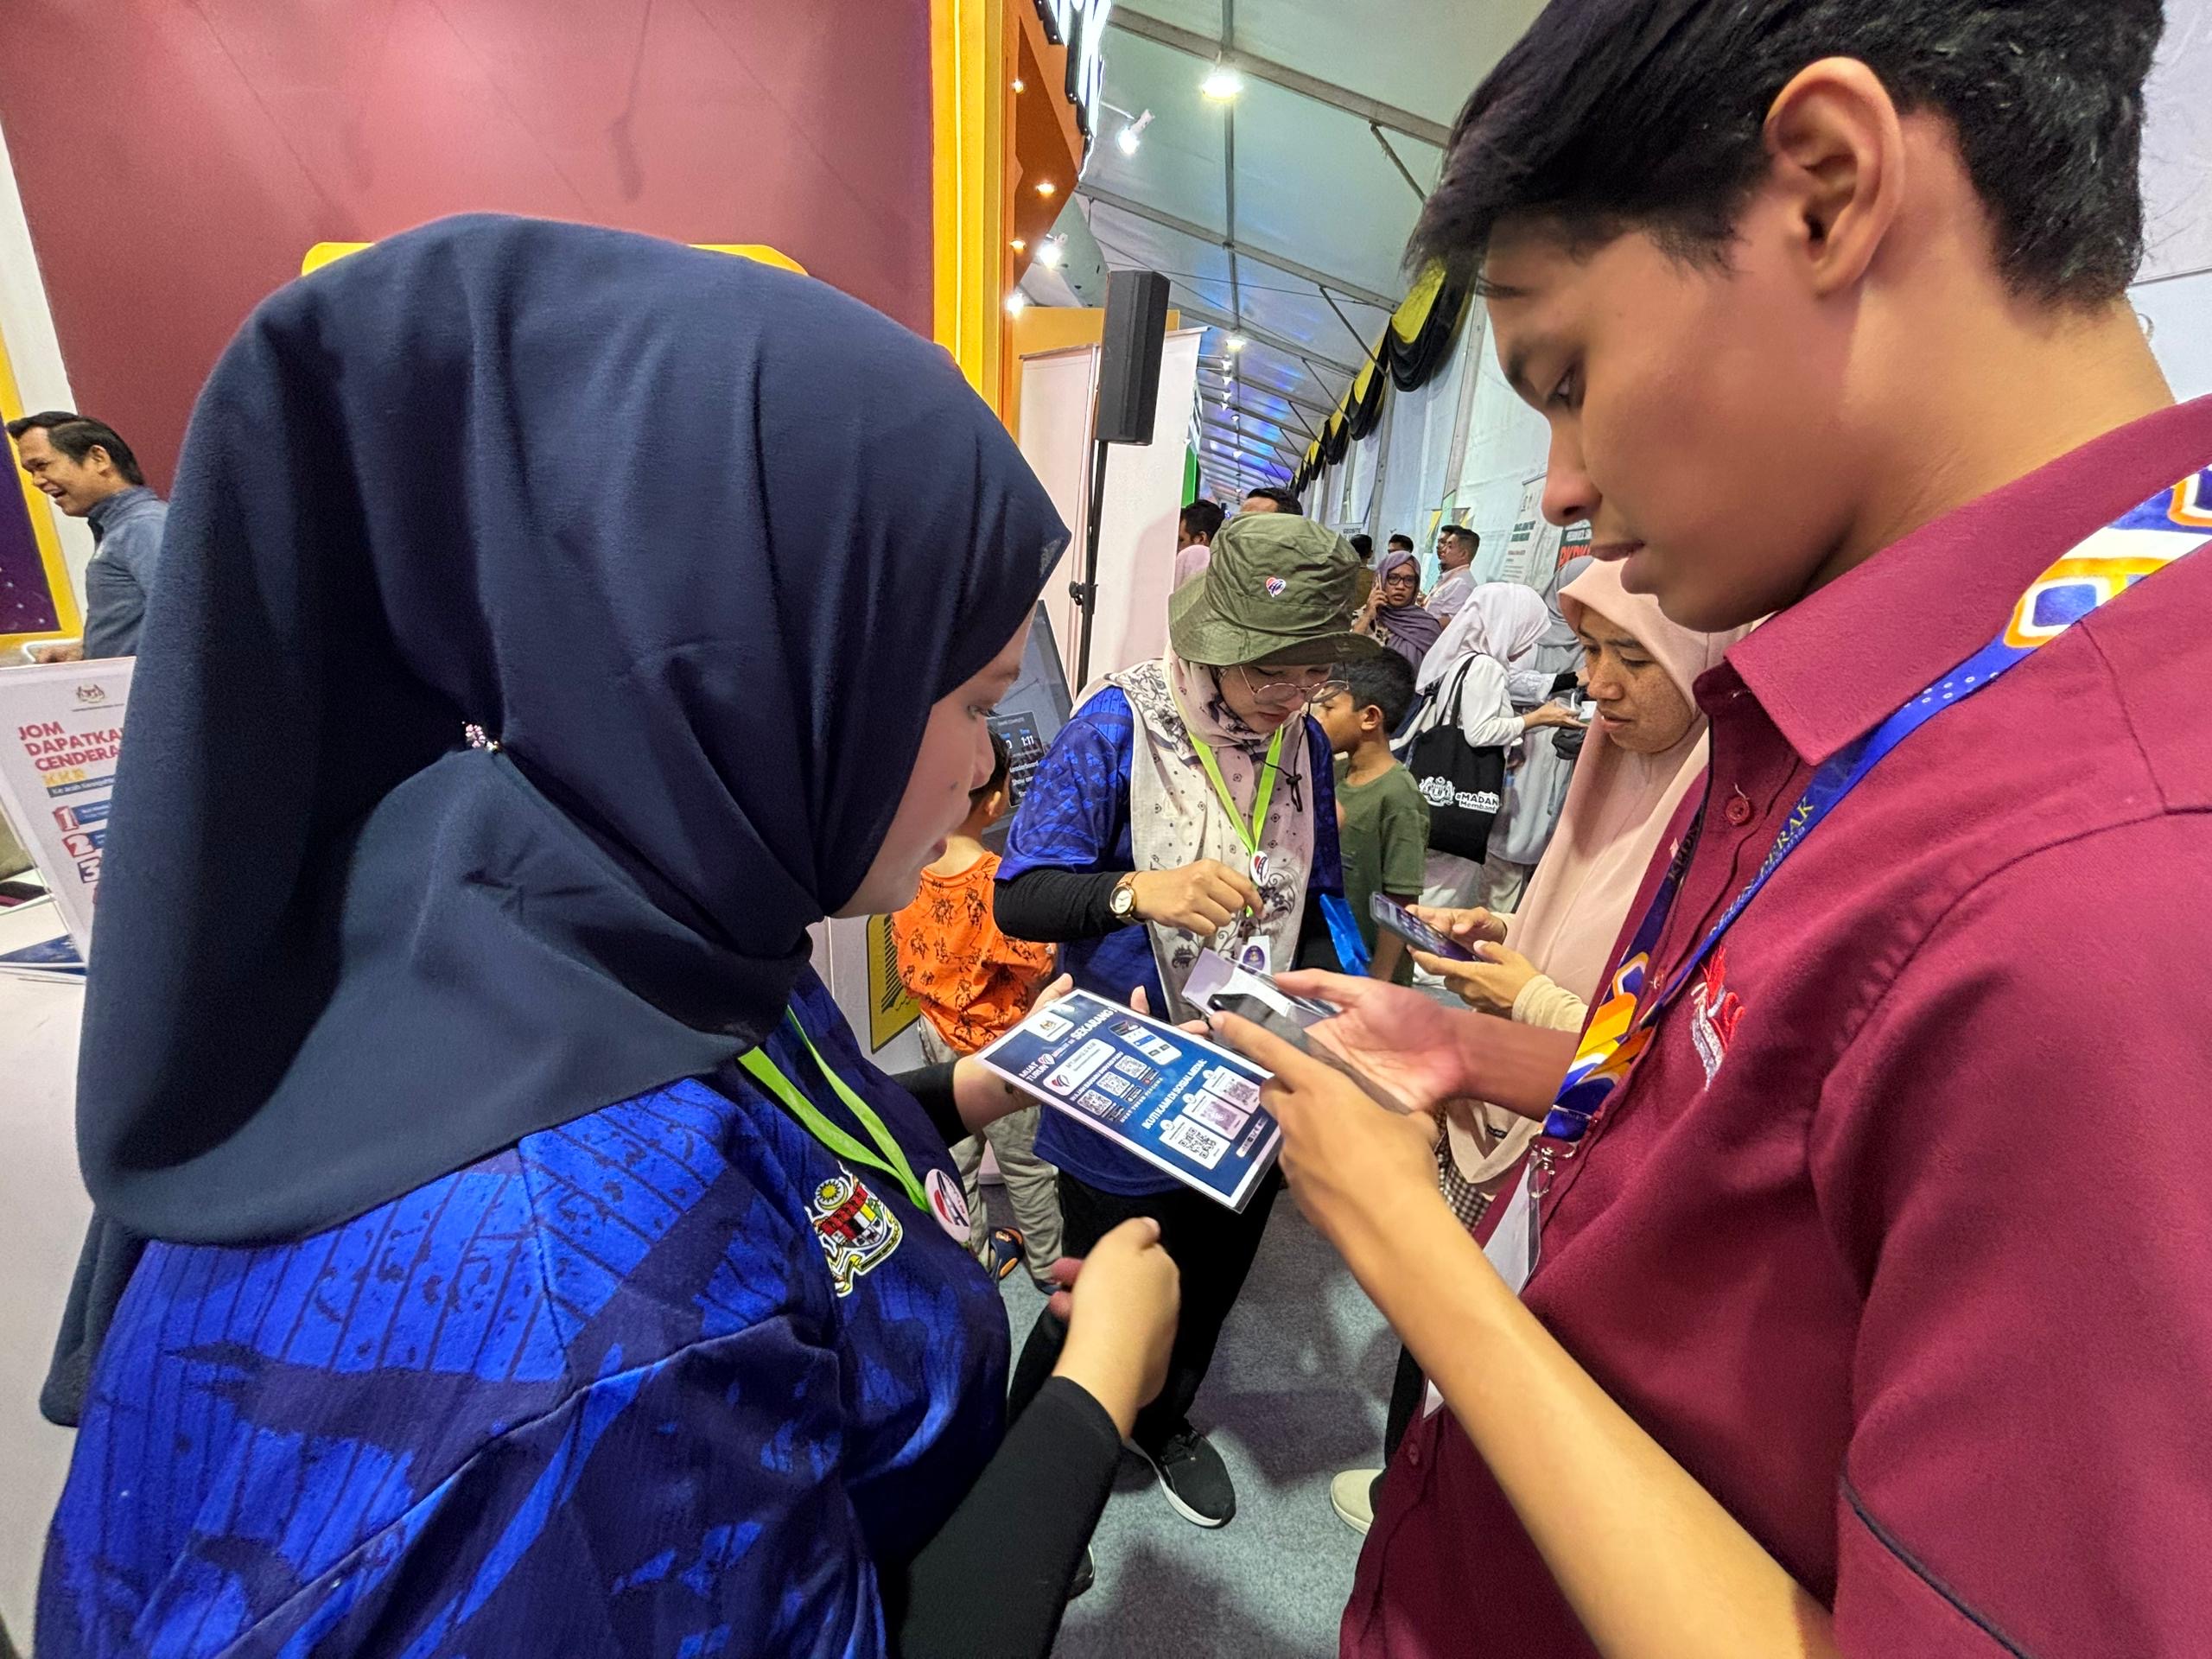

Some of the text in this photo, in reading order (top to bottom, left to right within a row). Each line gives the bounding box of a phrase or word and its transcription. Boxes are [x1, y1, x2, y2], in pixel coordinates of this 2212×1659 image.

[18, 721, 65, 741] JOM
[1020, 735, 1034, 747] 1:11
[1071, 1007, 1115, 1040] SEKARANG
[1019, 1061, 1039, 1078] MUAT
[1026, 1064, 1049, 1082] TURUN
[1141, 1111, 1160, 1129] IKUTI
[1154, 1096, 1173, 1115] KAMI
[1166, 1090, 1178, 1100] DI
[1172, 1074, 1192, 1095] SOSIAL
